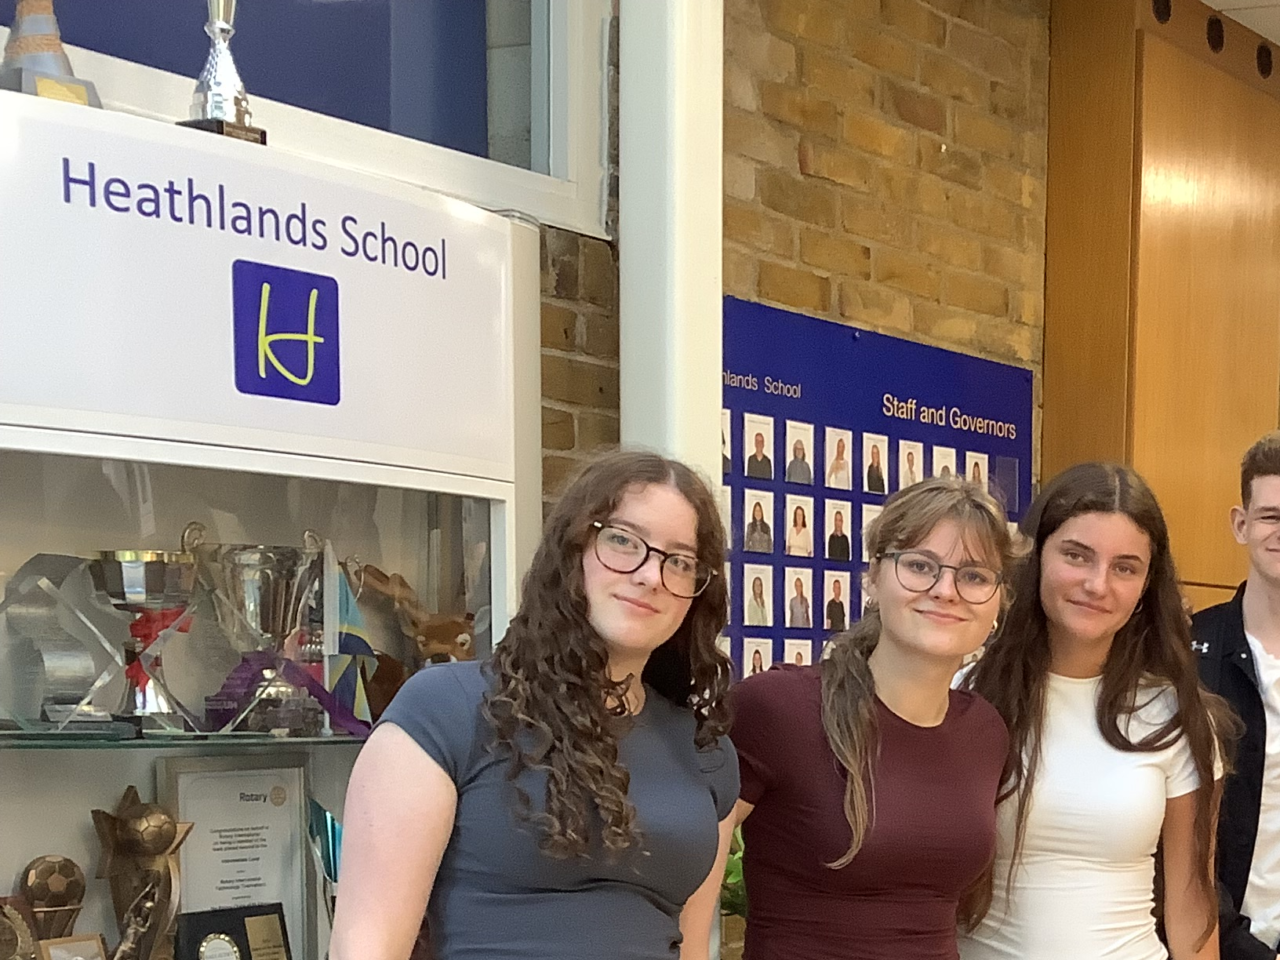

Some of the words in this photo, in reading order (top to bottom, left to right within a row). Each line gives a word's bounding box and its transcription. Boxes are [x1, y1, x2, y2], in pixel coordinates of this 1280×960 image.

[61, 156, 328, 251] Heathlands
[340, 215, 447, 280] School
[764, 375, 802, 399] School
[882, 393, 917, 420] Staff
[920, 405, 946, 427] and
[949, 407, 1017, 440] Governors
[239, 792, 268, 803] Rotary
